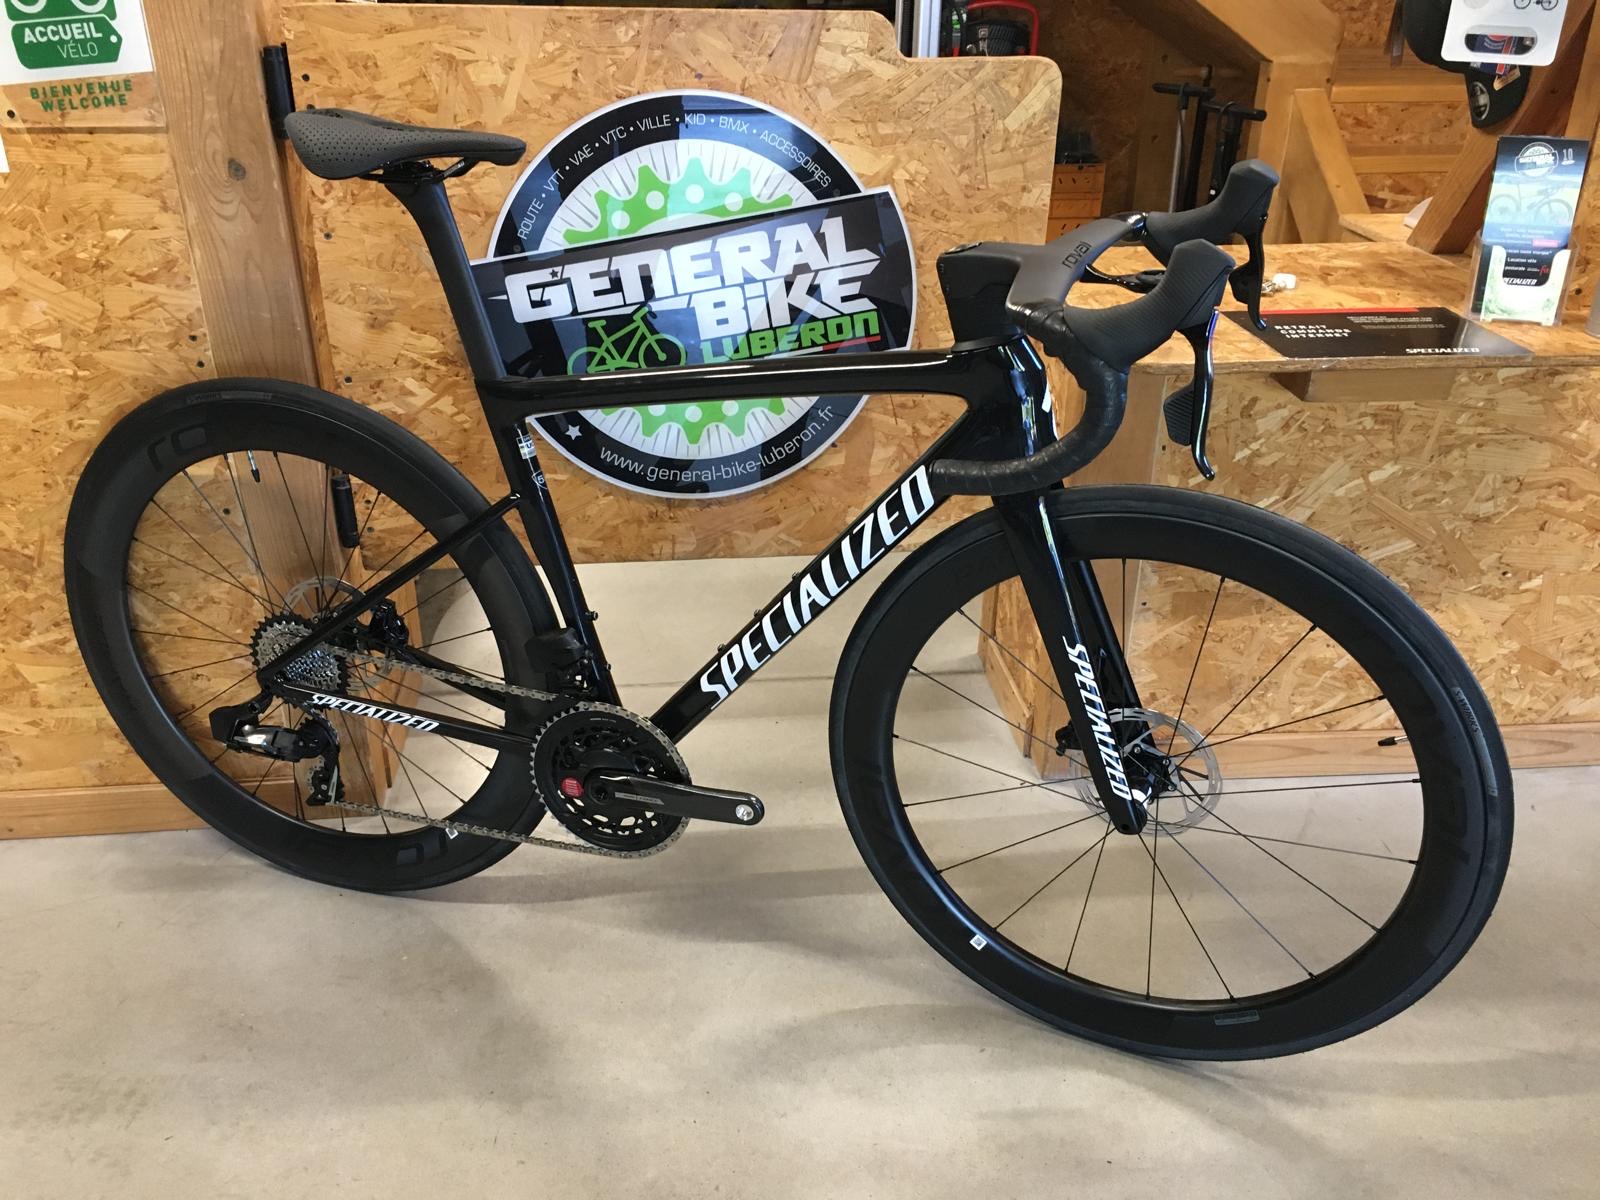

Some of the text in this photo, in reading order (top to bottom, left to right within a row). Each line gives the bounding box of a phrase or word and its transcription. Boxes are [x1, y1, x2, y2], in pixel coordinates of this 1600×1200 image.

[23, 22, 103, 44] ACCUEIL
[57, 40, 99, 58] VÉLO
[30, 79, 133, 100] BIENVENUE
[40, 94, 128, 112] WELCOME
[517, 113, 832, 240] ROUTE VTT VAE VTC VILLE KID BMX ACCESSOIRES
[505, 215, 881, 324] GENERAL
[1062, 241, 1092, 269] roval
[702, 310, 880, 364] LUBERON
[600, 405, 834, 481] www.general-bike-luberon.fr
[700, 464, 936, 709] SPECIALIZED
[312, 693, 440, 732] SPECIALIZED
[1062, 635, 1133, 801] SPECIALIZED
